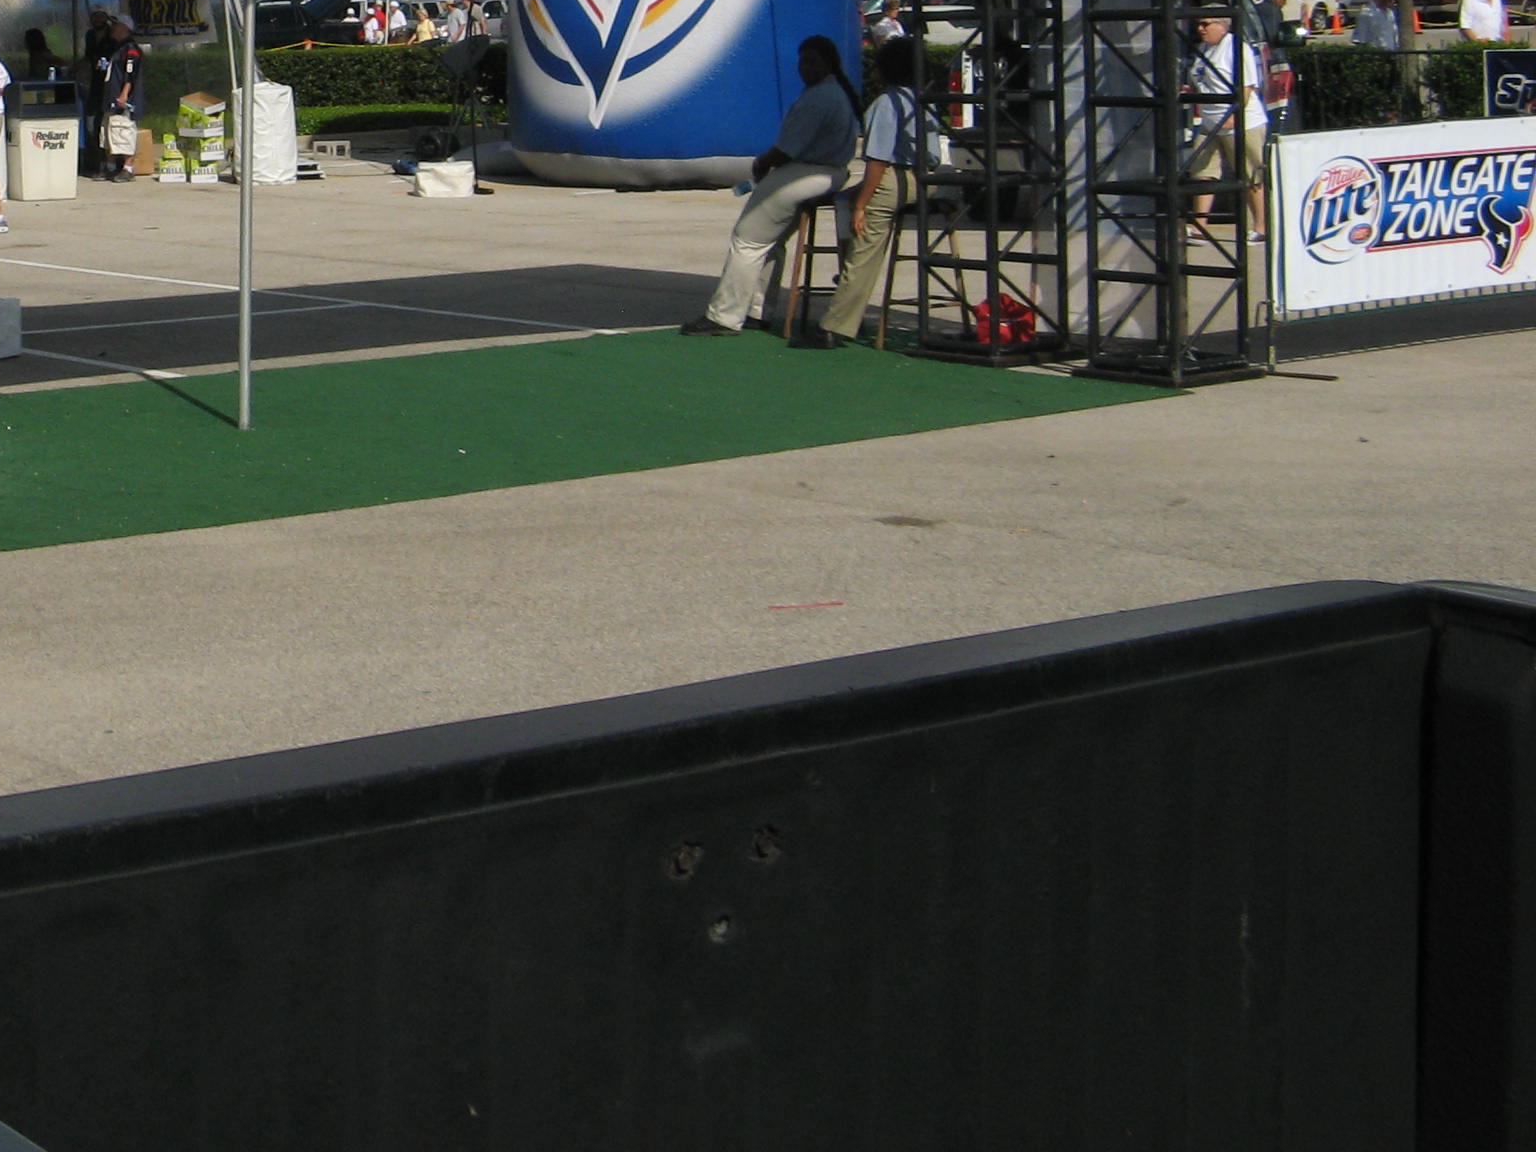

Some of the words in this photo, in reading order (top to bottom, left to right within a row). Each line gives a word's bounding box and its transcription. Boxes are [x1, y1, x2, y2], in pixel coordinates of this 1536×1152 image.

[36, 131, 69, 140] Reliant
[43, 141, 65, 150] Park
[1387, 153, 1536, 203] TAILGATE
[1307, 180, 1378, 247] Lite
[1383, 197, 1477, 242] ZONE
